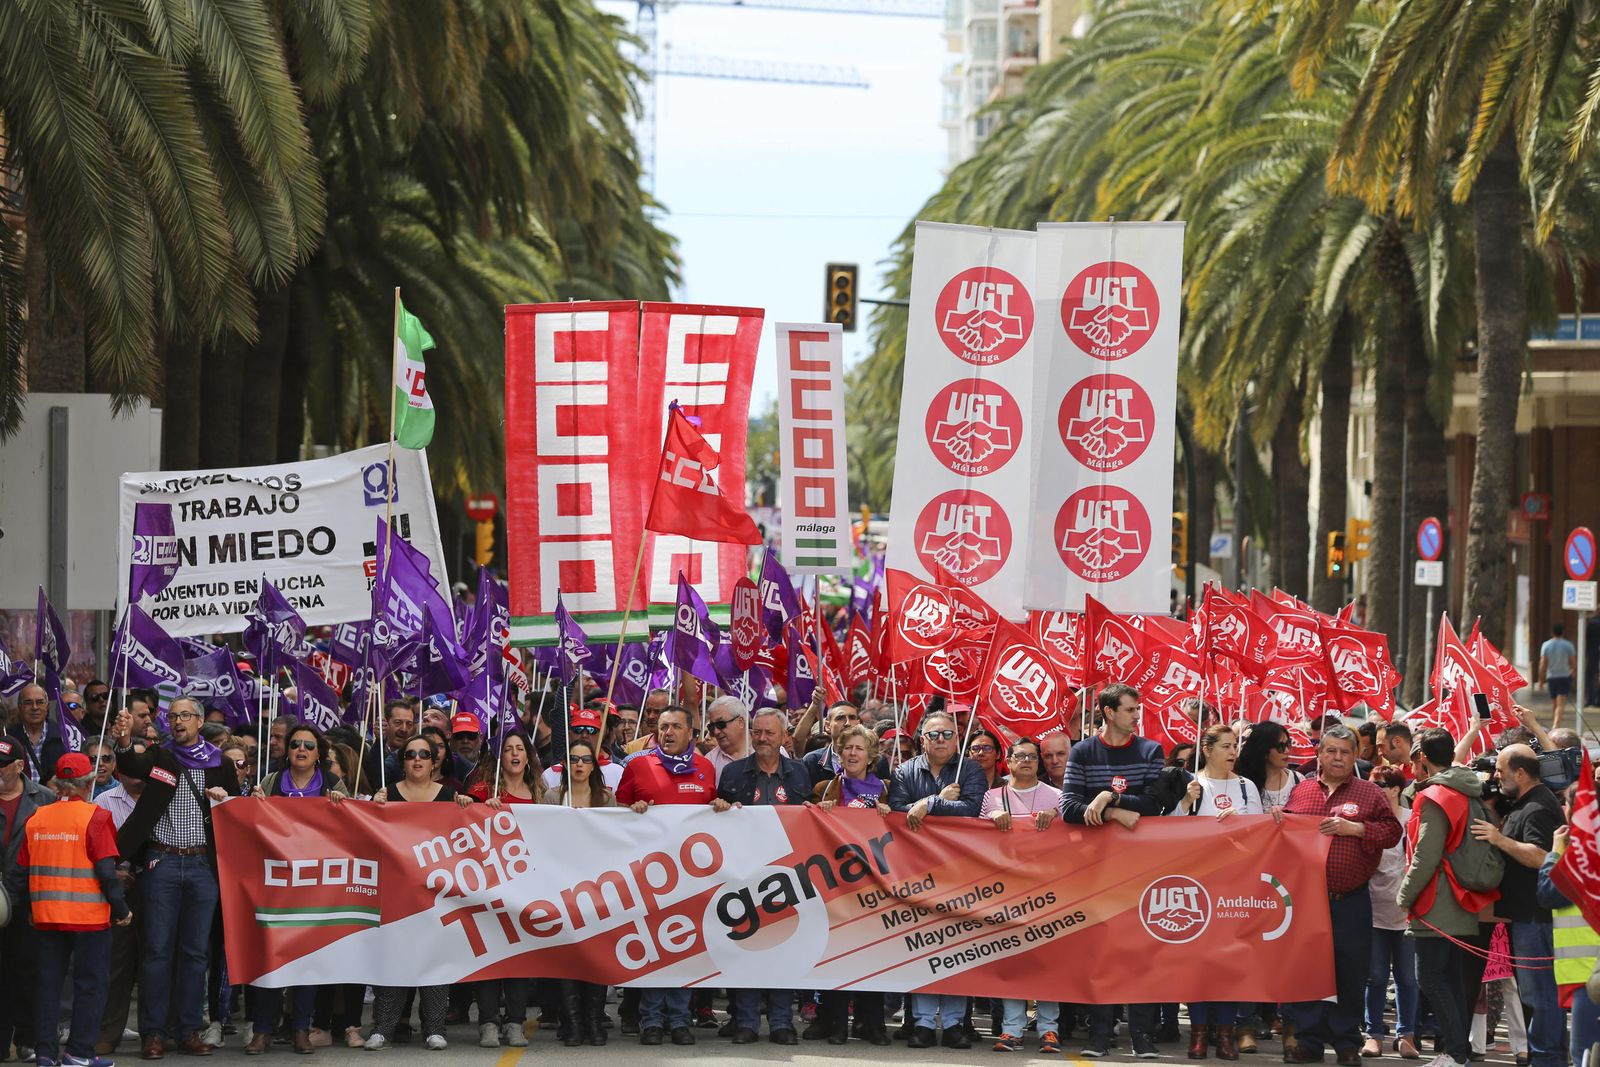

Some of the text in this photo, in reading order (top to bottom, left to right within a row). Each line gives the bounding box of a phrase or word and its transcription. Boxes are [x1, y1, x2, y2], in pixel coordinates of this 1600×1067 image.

[957, 280, 1014, 315] UGT
[1083, 276, 1138, 309] UGT
[962, 350, 1000, 363] Málaga
[1090, 345, 1128, 357] Málaga
[947, 391, 1002, 426] UGT
[1079, 388, 1133, 420] UGT
[788, 330, 836, 518] CCOO
[535, 311, 617, 613] CCOO
[650, 314, 739, 603] CCO
[951, 460, 989, 474] Málaga
[1086, 457, 1124, 470] Málaga
[178, 493, 300, 522] TRABAJO
[935, 502, 991, 537] UGT
[1074, 498, 1129, 531] UGT
[208, 526, 337, 564] MIEDO
[796, 523, 836, 534] málaga
[155, 574, 325, 603] JUVENTUD EN UCHA
[1081, 568, 1120, 580] Málaga
[152, 604, 180, 621] POR
[184, 602, 219, 617] UNA
[734, 586, 760, 623] UGT
[905, 593, 950, 630] UGT
[999, 649, 1056, 707] UGT
[1163, 661, 1203, 691] GT
[412, 811, 518, 868] mayo
[264, 857, 379, 888] CCOO
[426, 838, 531, 904] 2018
[345, 884, 378, 896] málaga
[440, 832, 724, 958] Tiempo
[615, 831, 894, 971] de ganar
[935, 881, 1005, 915] empleo
[1149, 886, 1199, 914] UGT
[1216, 896, 1278, 909] Andalucía
[904, 891, 1057, 952] Mayores salarios
[1216, 911, 1250, 919] MÁLAGA
[928, 910, 1087, 974] Pensiones dignas
